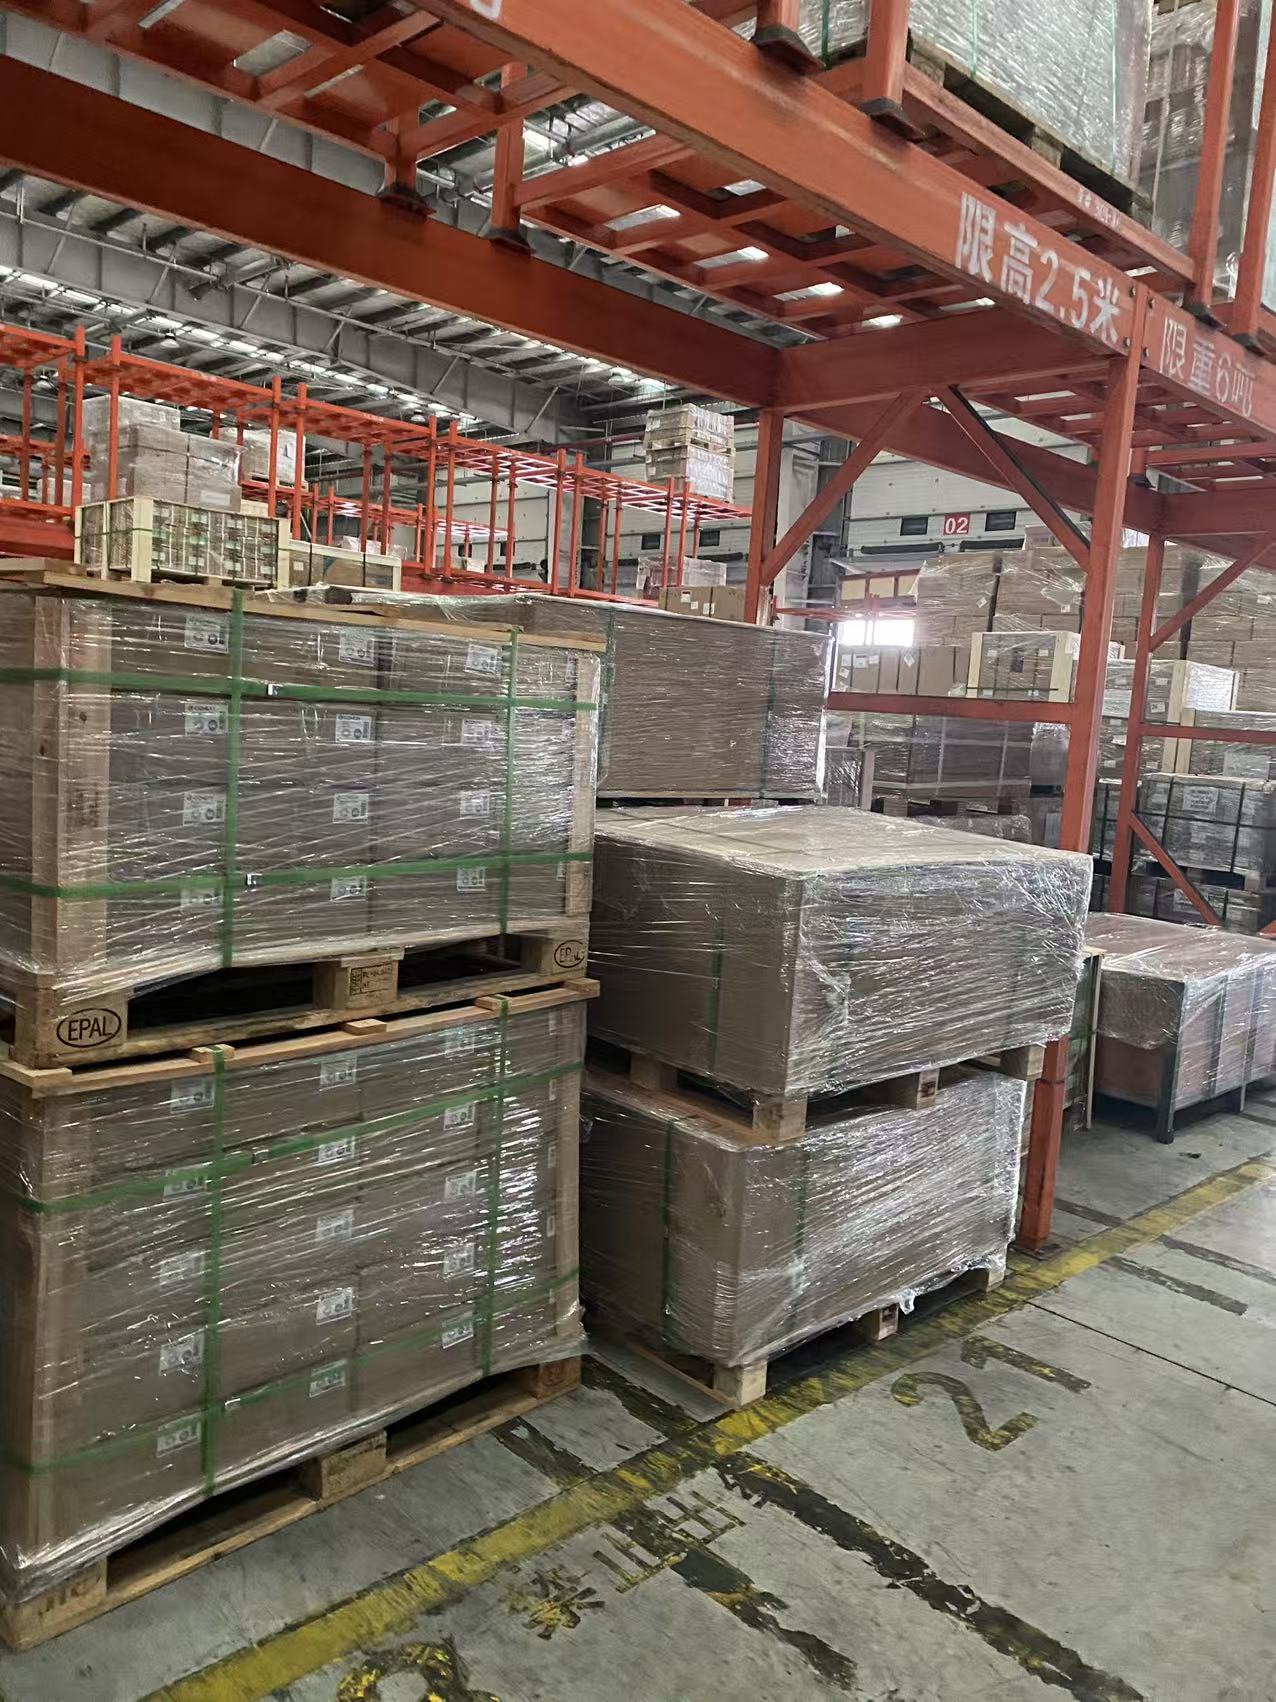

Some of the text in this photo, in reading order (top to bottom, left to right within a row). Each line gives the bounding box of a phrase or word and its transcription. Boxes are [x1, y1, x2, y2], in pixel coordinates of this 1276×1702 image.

[955, 191, 1119, 344] 限高2.5米
[1159, 317, 1256, 418] 限重6吨
[945, 517, 969, 535] 02
[67, 1015, 113, 1041] EPAL
[890, 1335, 1092, 1451] 21
